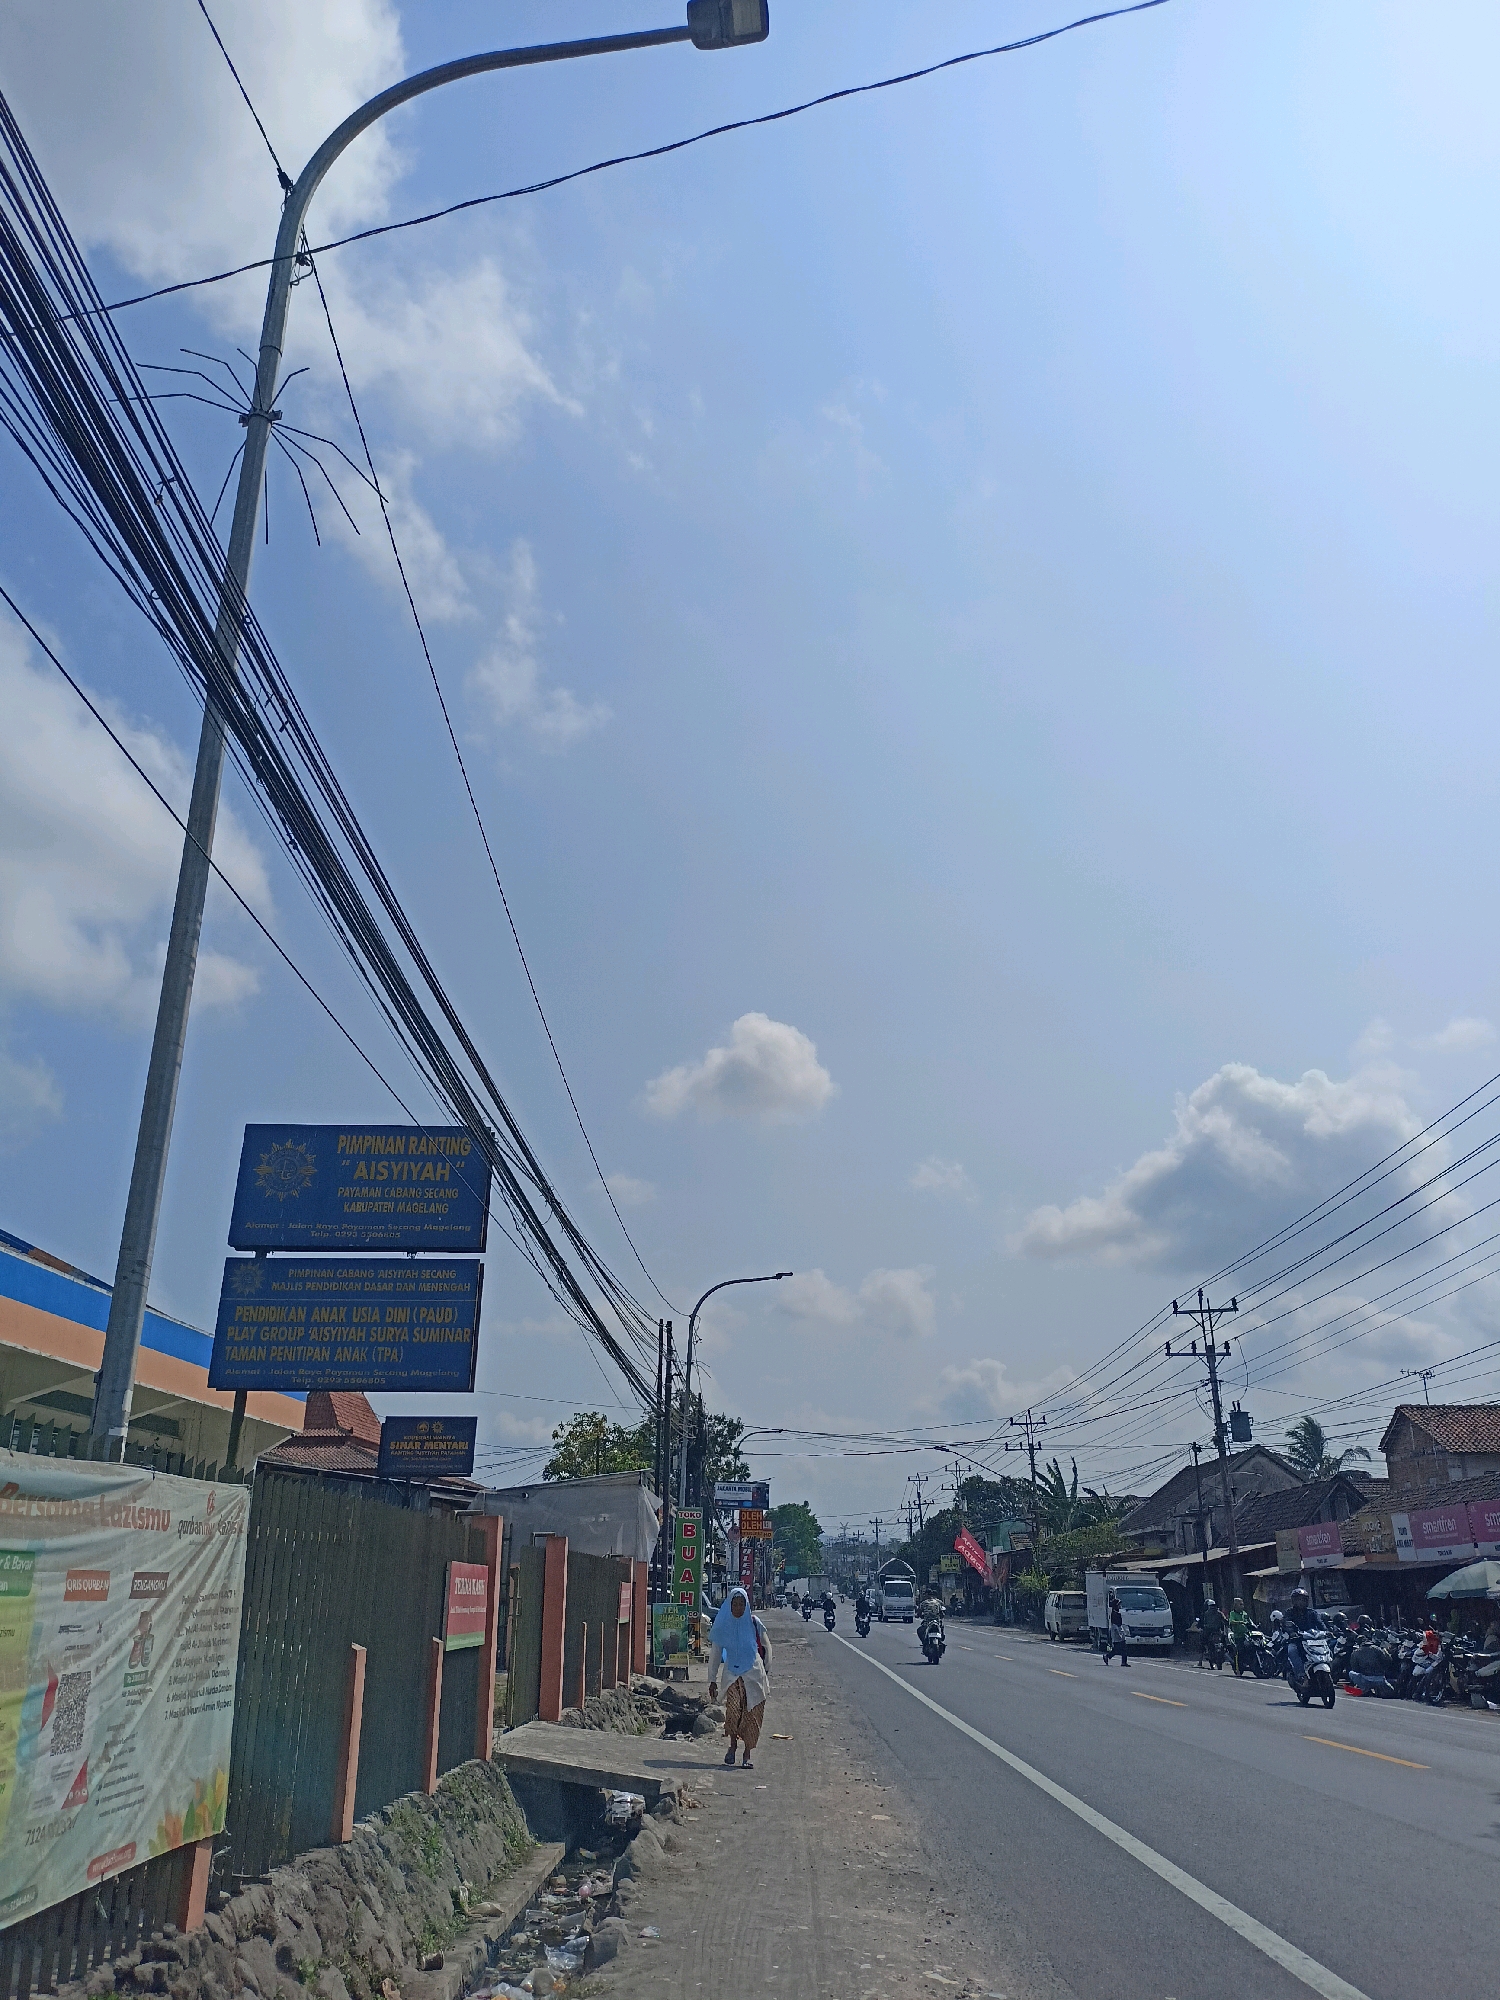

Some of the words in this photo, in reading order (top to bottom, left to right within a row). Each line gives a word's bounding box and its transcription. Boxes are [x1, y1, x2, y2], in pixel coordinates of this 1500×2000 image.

[337, 1135, 405, 1155] PIMPINAN
[408, 1136, 472, 1156] RANTING
[338, 1187, 382, 1198] PAYAMAN
[384, 1187, 422, 1199] CABANG
[424, 1188, 459, 1199] SECANG
[343, 1202, 394, 1213] KABUPATEN
[397, 1203, 449, 1214] MAGELANG
[424, 1224, 471, 1232] Magelang
[288, 1269, 334, 1279] PIMPINAN
[336, 1269, 374, 1279] CABANG
[421, 1270, 457, 1279] SECANG
[271, 1282, 303, 1291] MAJLIS
[305, 1282, 361, 1291] PENDIDIKAN
[363, 1282, 394, 1292] DASAR
[396, 1283, 416, 1292] DAN
[418, 1283, 471, 1292] MENENGAH
[234, 1305, 305, 1323] PENDIDIKAN
[311, 1307, 345, 1323] ANAK
[352, 1307, 380, 1323] USIA
[385, 1307, 410, 1323] DINI
[412, 1307, 458, 1324] (PAUD)
[227, 1326, 255, 1342] PLAY
[260, 1326, 304, 1342] GROUP
[369, 1327, 408, 1342] SURYA
[412, 1327, 471, 1343] SUMINAR
[225, 1345, 266, 1362] TAMAN
[269, 1345, 330, 1362] PENITIPAN
[336, 1346, 367, 1362] ANAK
[372, 1346, 404, 1363] (TPA)
[389, 1441, 422, 1450] SINAR
[423, 1441, 469, 1450] MENTARI
[100, 1494, 171, 1532] Lazismu
[678, 1511, 702, 1519] TOKO
[1422, 1515, 1457, 1535] smartfren
[679, 1522, 697, 1607] BUAH
[66, 1578, 82, 1592] QRIS
